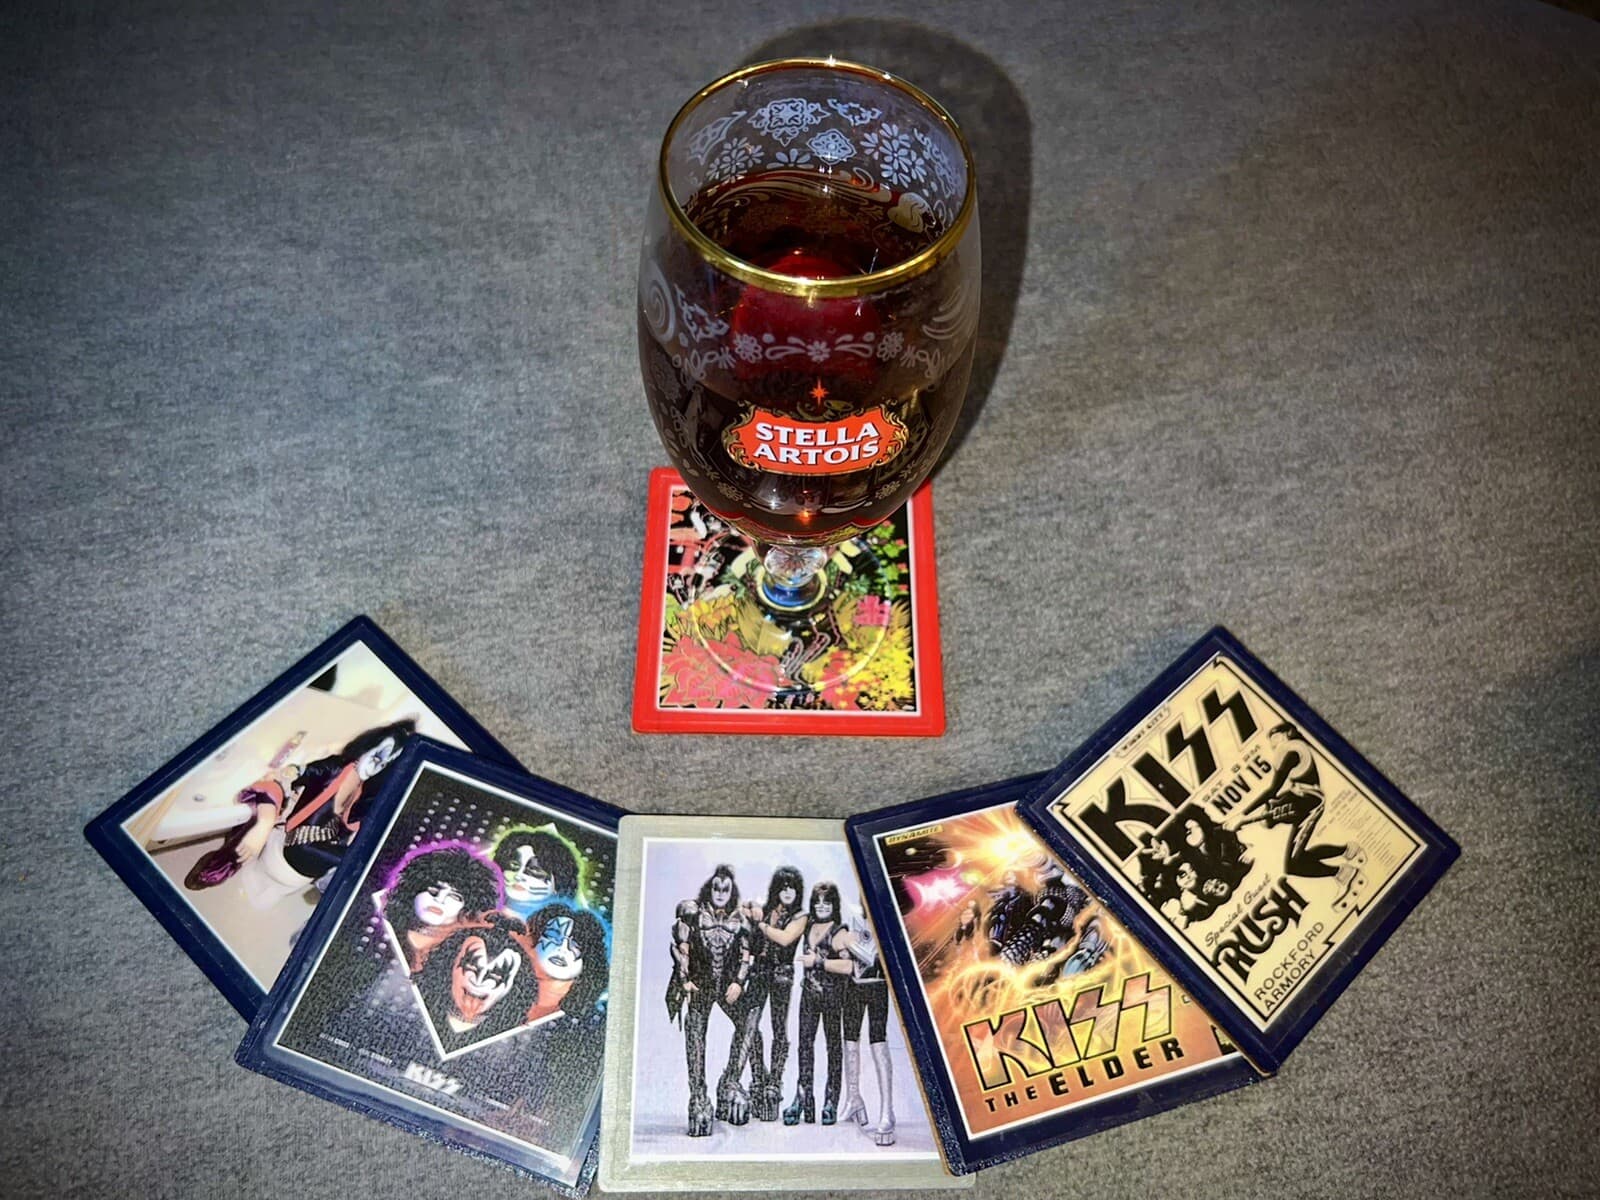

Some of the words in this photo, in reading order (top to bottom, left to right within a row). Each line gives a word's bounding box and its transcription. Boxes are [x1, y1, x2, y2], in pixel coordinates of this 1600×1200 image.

[753, 439, 879, 465] ARTOIS
[755, 422, 879, 446] STELLA
[1078, 689, 1258, 862] KISS
[1212, 774, 1251, 815] NOV
[1246, 755, 1271, 780] 15
[1205, 903, 1242, 947] Special
[1243, 873, 1270, 905] Guest
[1212, 876, 1309, 985] RUSH
[1254, 922, 1324, 1000] ROCKFORD
[1264, 949, 1316, 1011] ARMORY
[963, 972, 1172, 1091] KISS
[404, 1061, 463, 1096] KISS
[986, 1086, 1037, 1112] THE
[1050, 1037, 1184, 1096] ELDER
